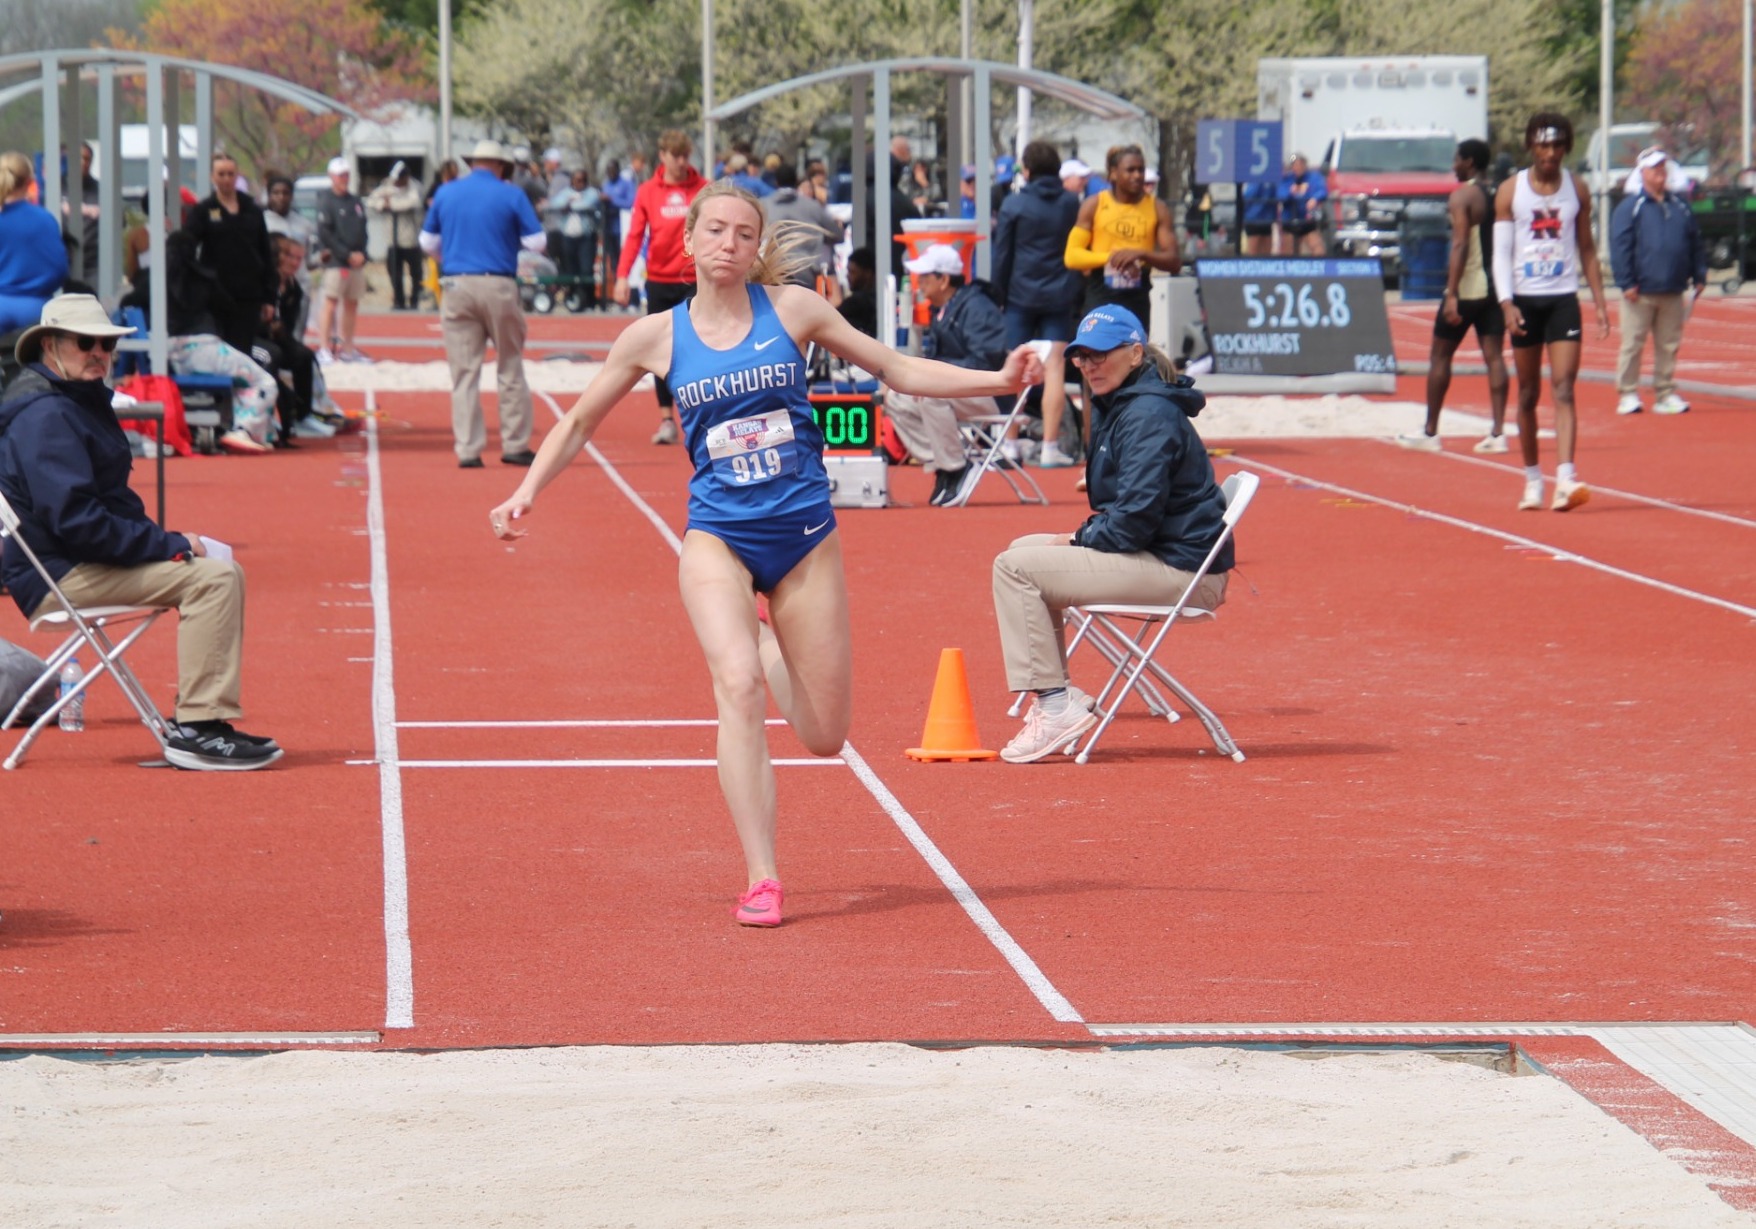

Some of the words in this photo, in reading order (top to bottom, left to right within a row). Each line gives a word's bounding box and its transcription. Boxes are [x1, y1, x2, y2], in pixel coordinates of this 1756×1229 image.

[1208, 128, 1223, 175] 5
[1250, 128, 1269, 175] 5
[1242, 282, 1351, 328] 5:26.8
[1212, 332, 1300, 355] ROCKHURST
[677, 362, 797, 410] ROCKHURST
[731, 448, 782, 483] 919
